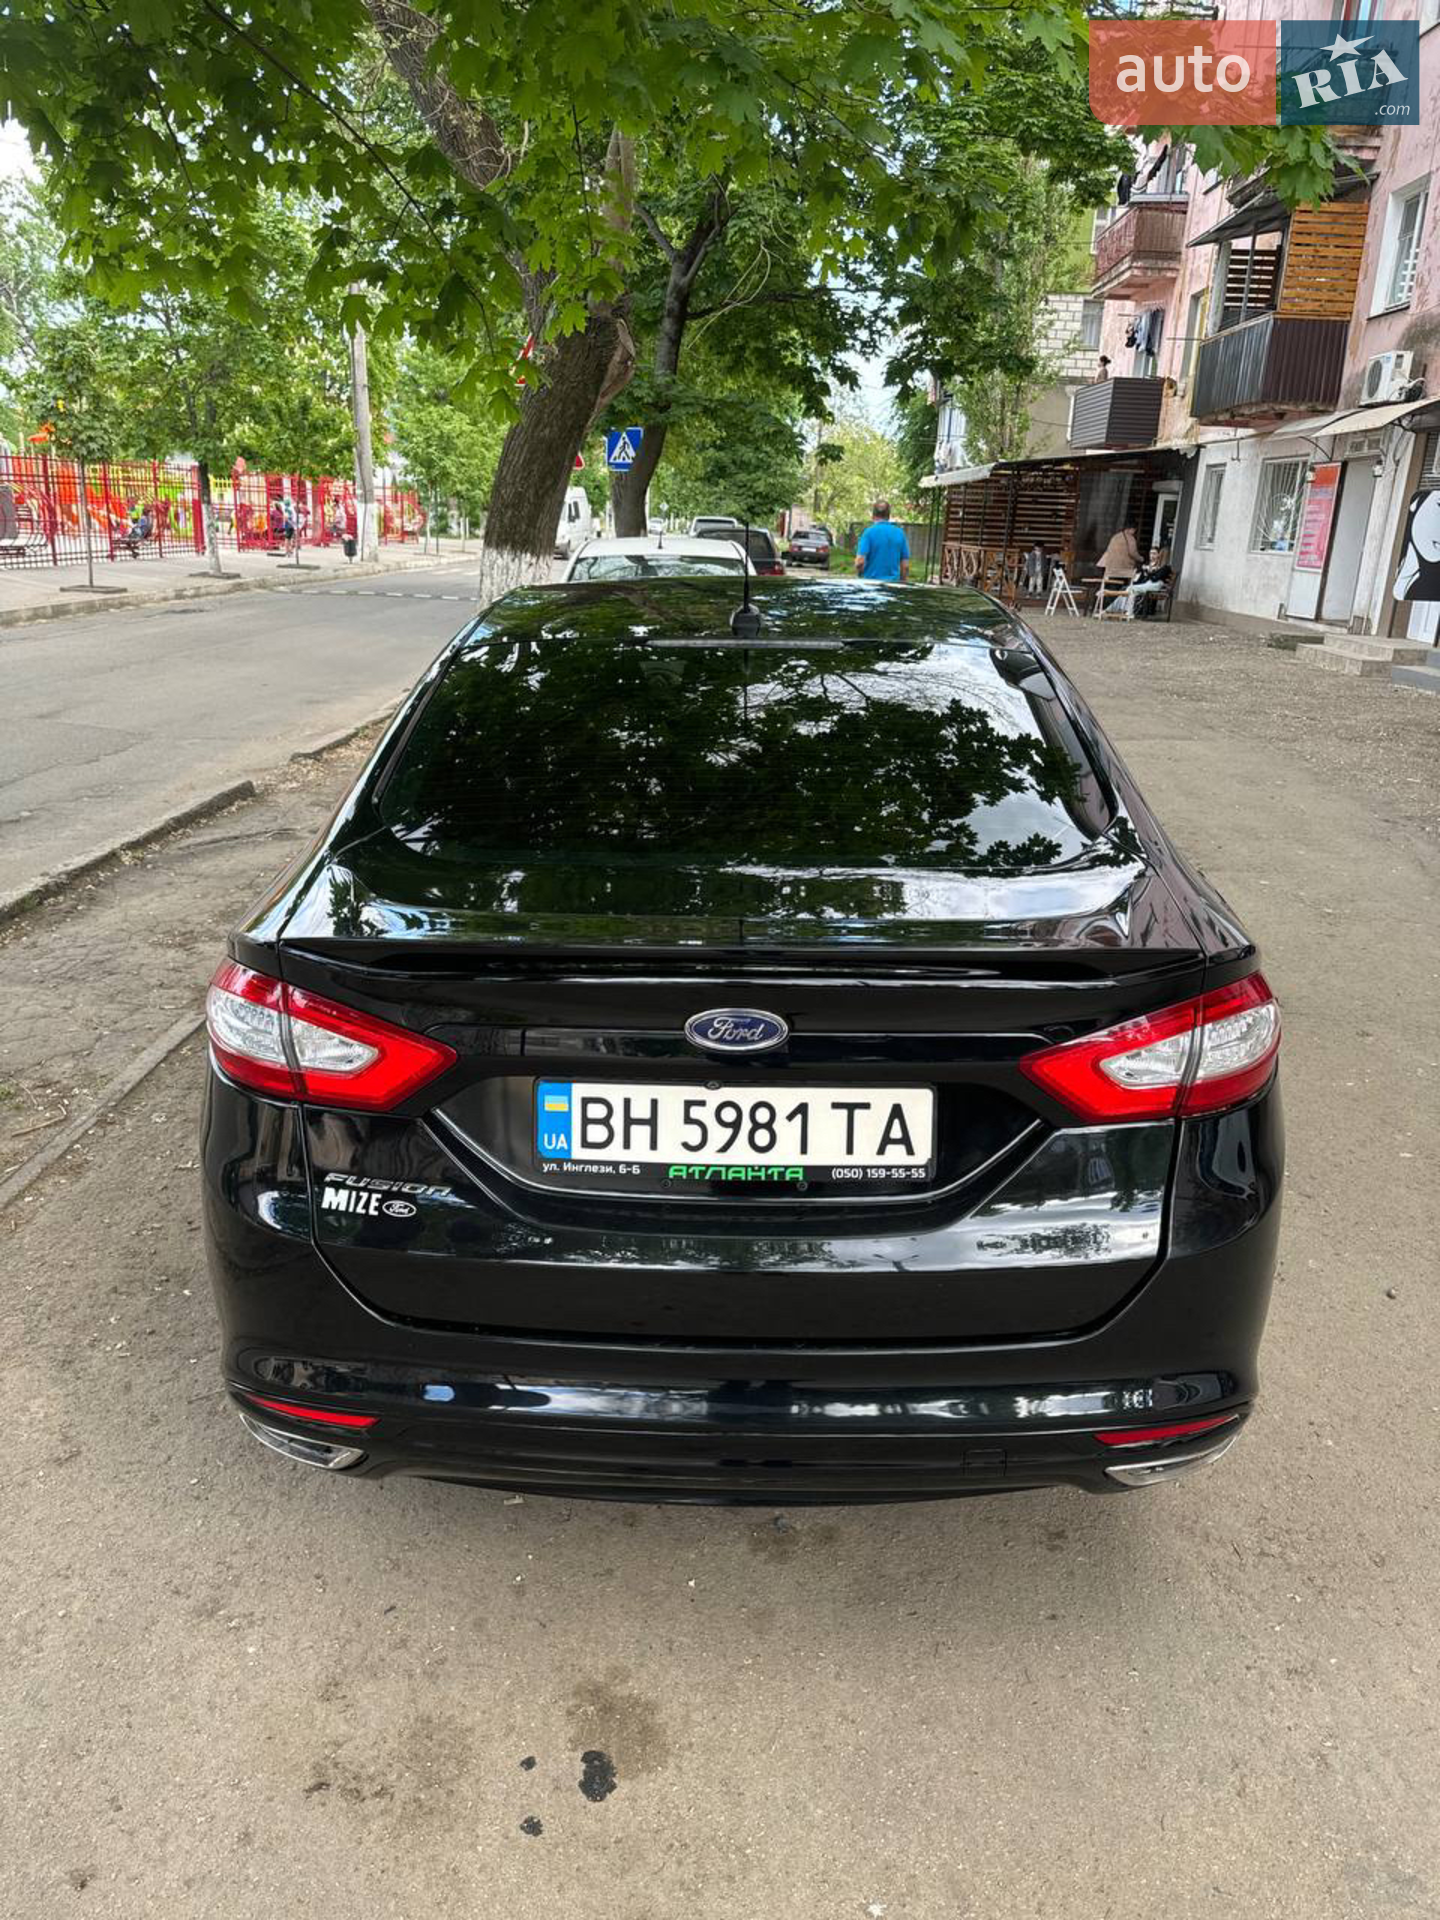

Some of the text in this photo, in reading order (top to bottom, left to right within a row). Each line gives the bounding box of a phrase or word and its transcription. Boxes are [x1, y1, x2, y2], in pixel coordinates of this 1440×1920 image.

[707, 1016, 765, 1041] Ford
[580, 1096, 915, 1156] BH 5981 TA
[543, 1133, 568, 1150] UA
[542, 1163, 560, 1172] ул.
[668, 1165, 804, 1181] АТЛАНТА
[831, 1168, 927, 1180] (050) 159-55-55
[321, 1186, 382, 1216] MIZE
